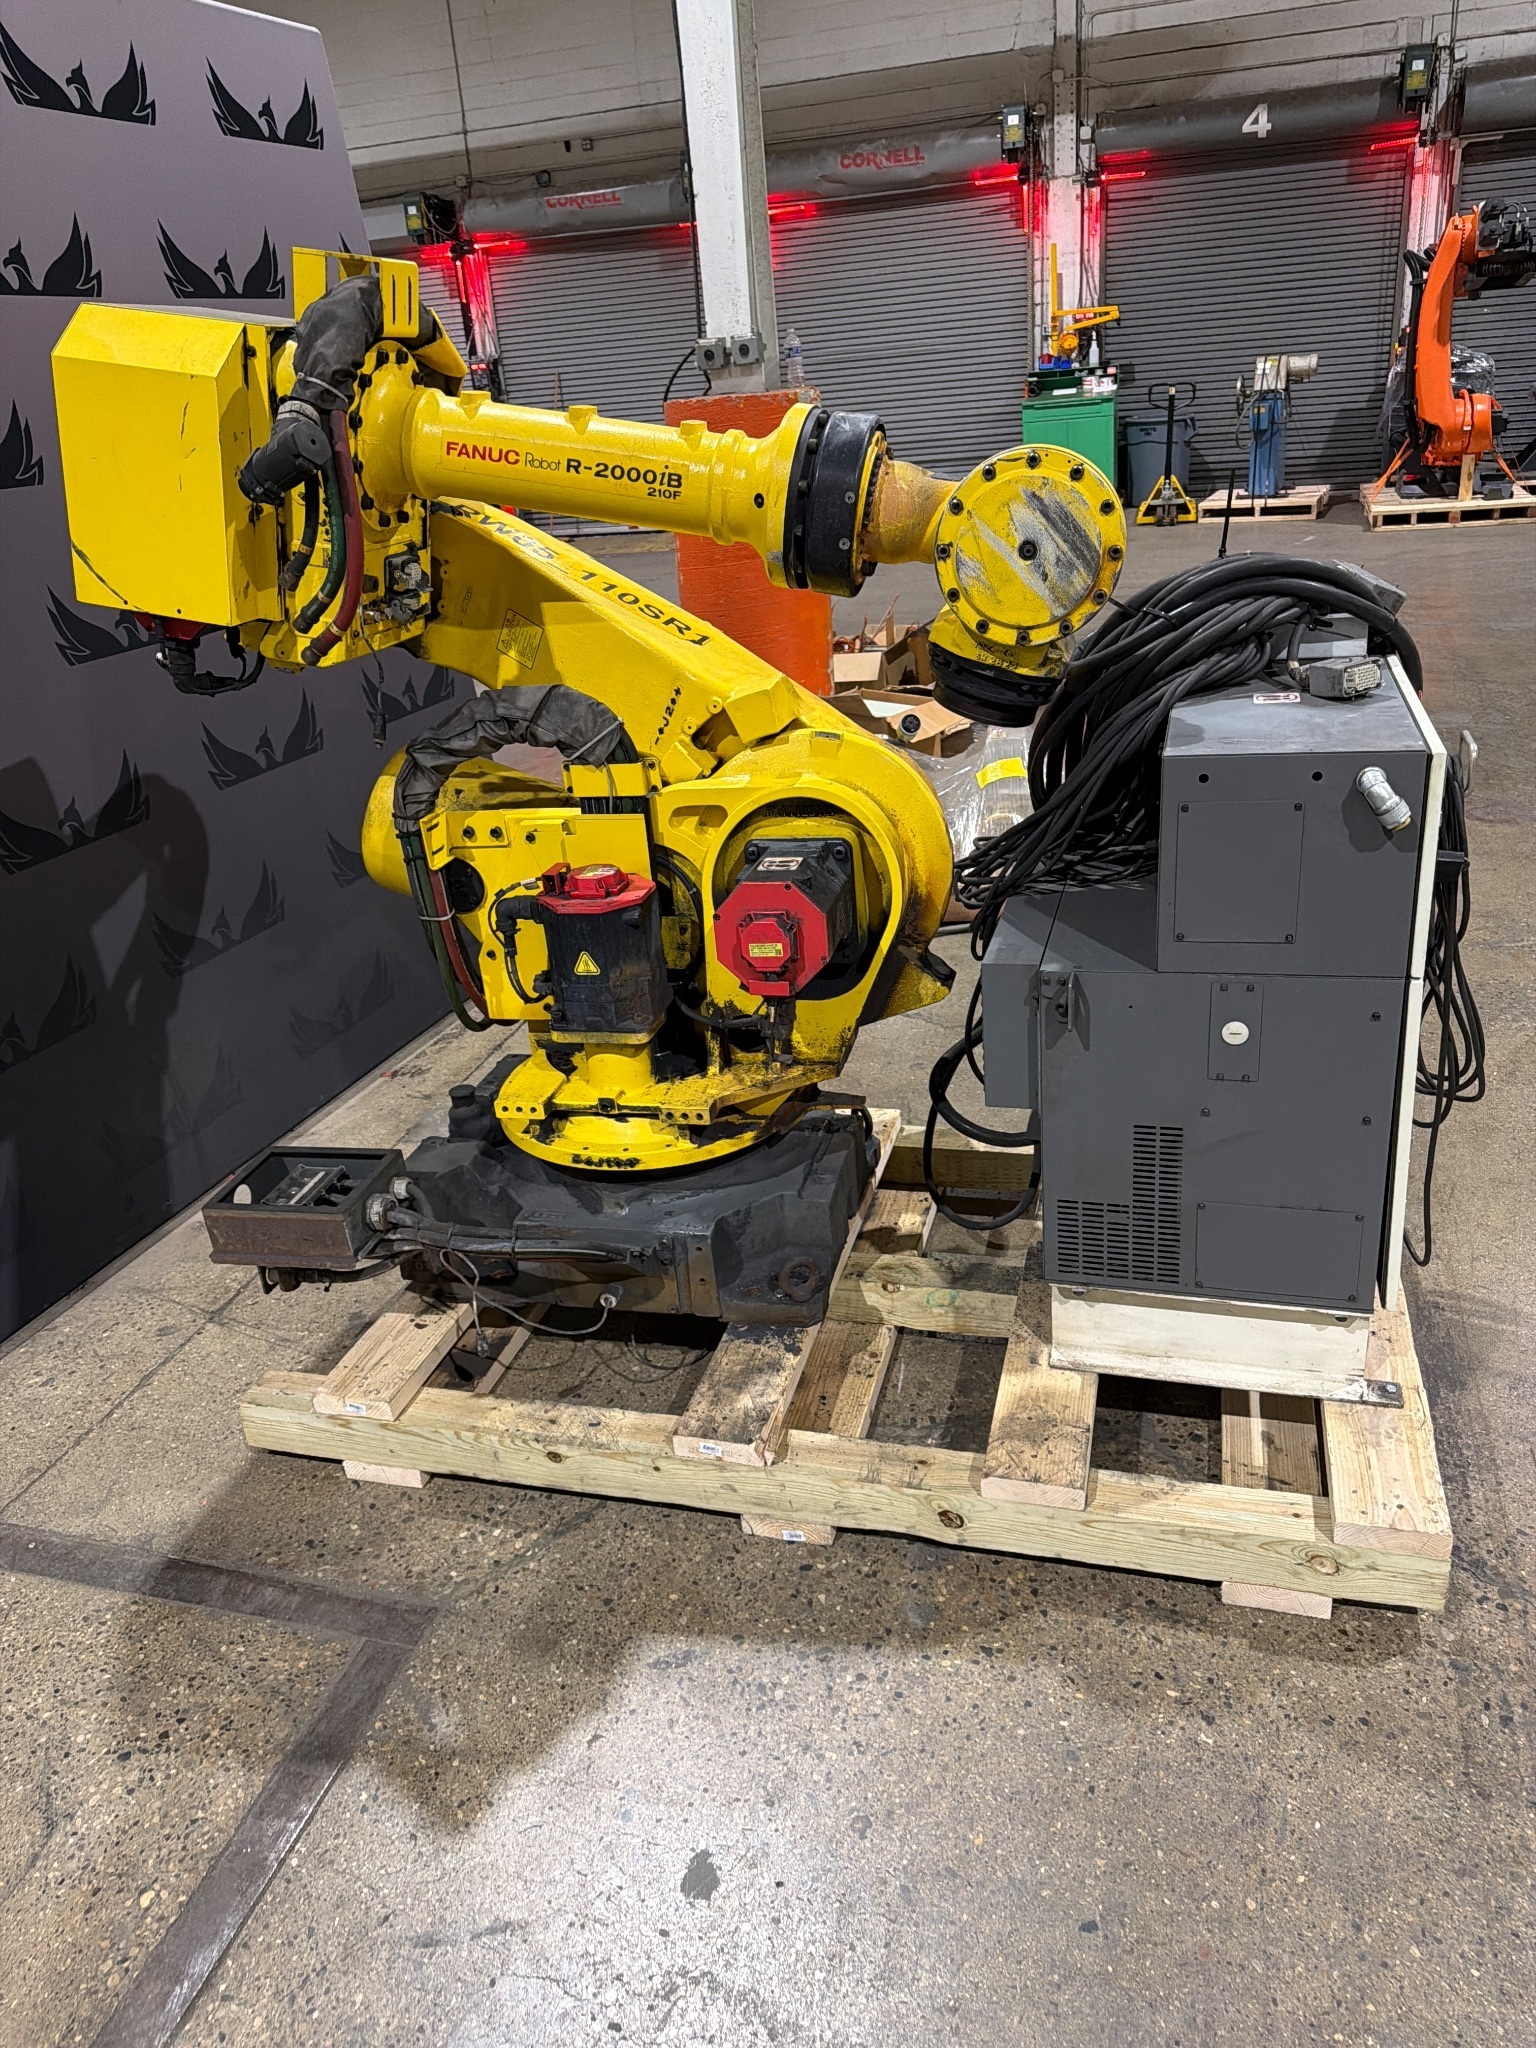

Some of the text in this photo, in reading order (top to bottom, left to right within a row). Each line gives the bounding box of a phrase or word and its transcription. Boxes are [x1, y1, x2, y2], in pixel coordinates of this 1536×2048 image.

[1242, 103, 1272, 138] 4
[840, 144, 925, 170] CORNELL
[546, 191, 622, 209] CORNELL
[446, 441, 683, 489] FANUC Robot R-2000iB
[647, 486, 683, 501] 210F
